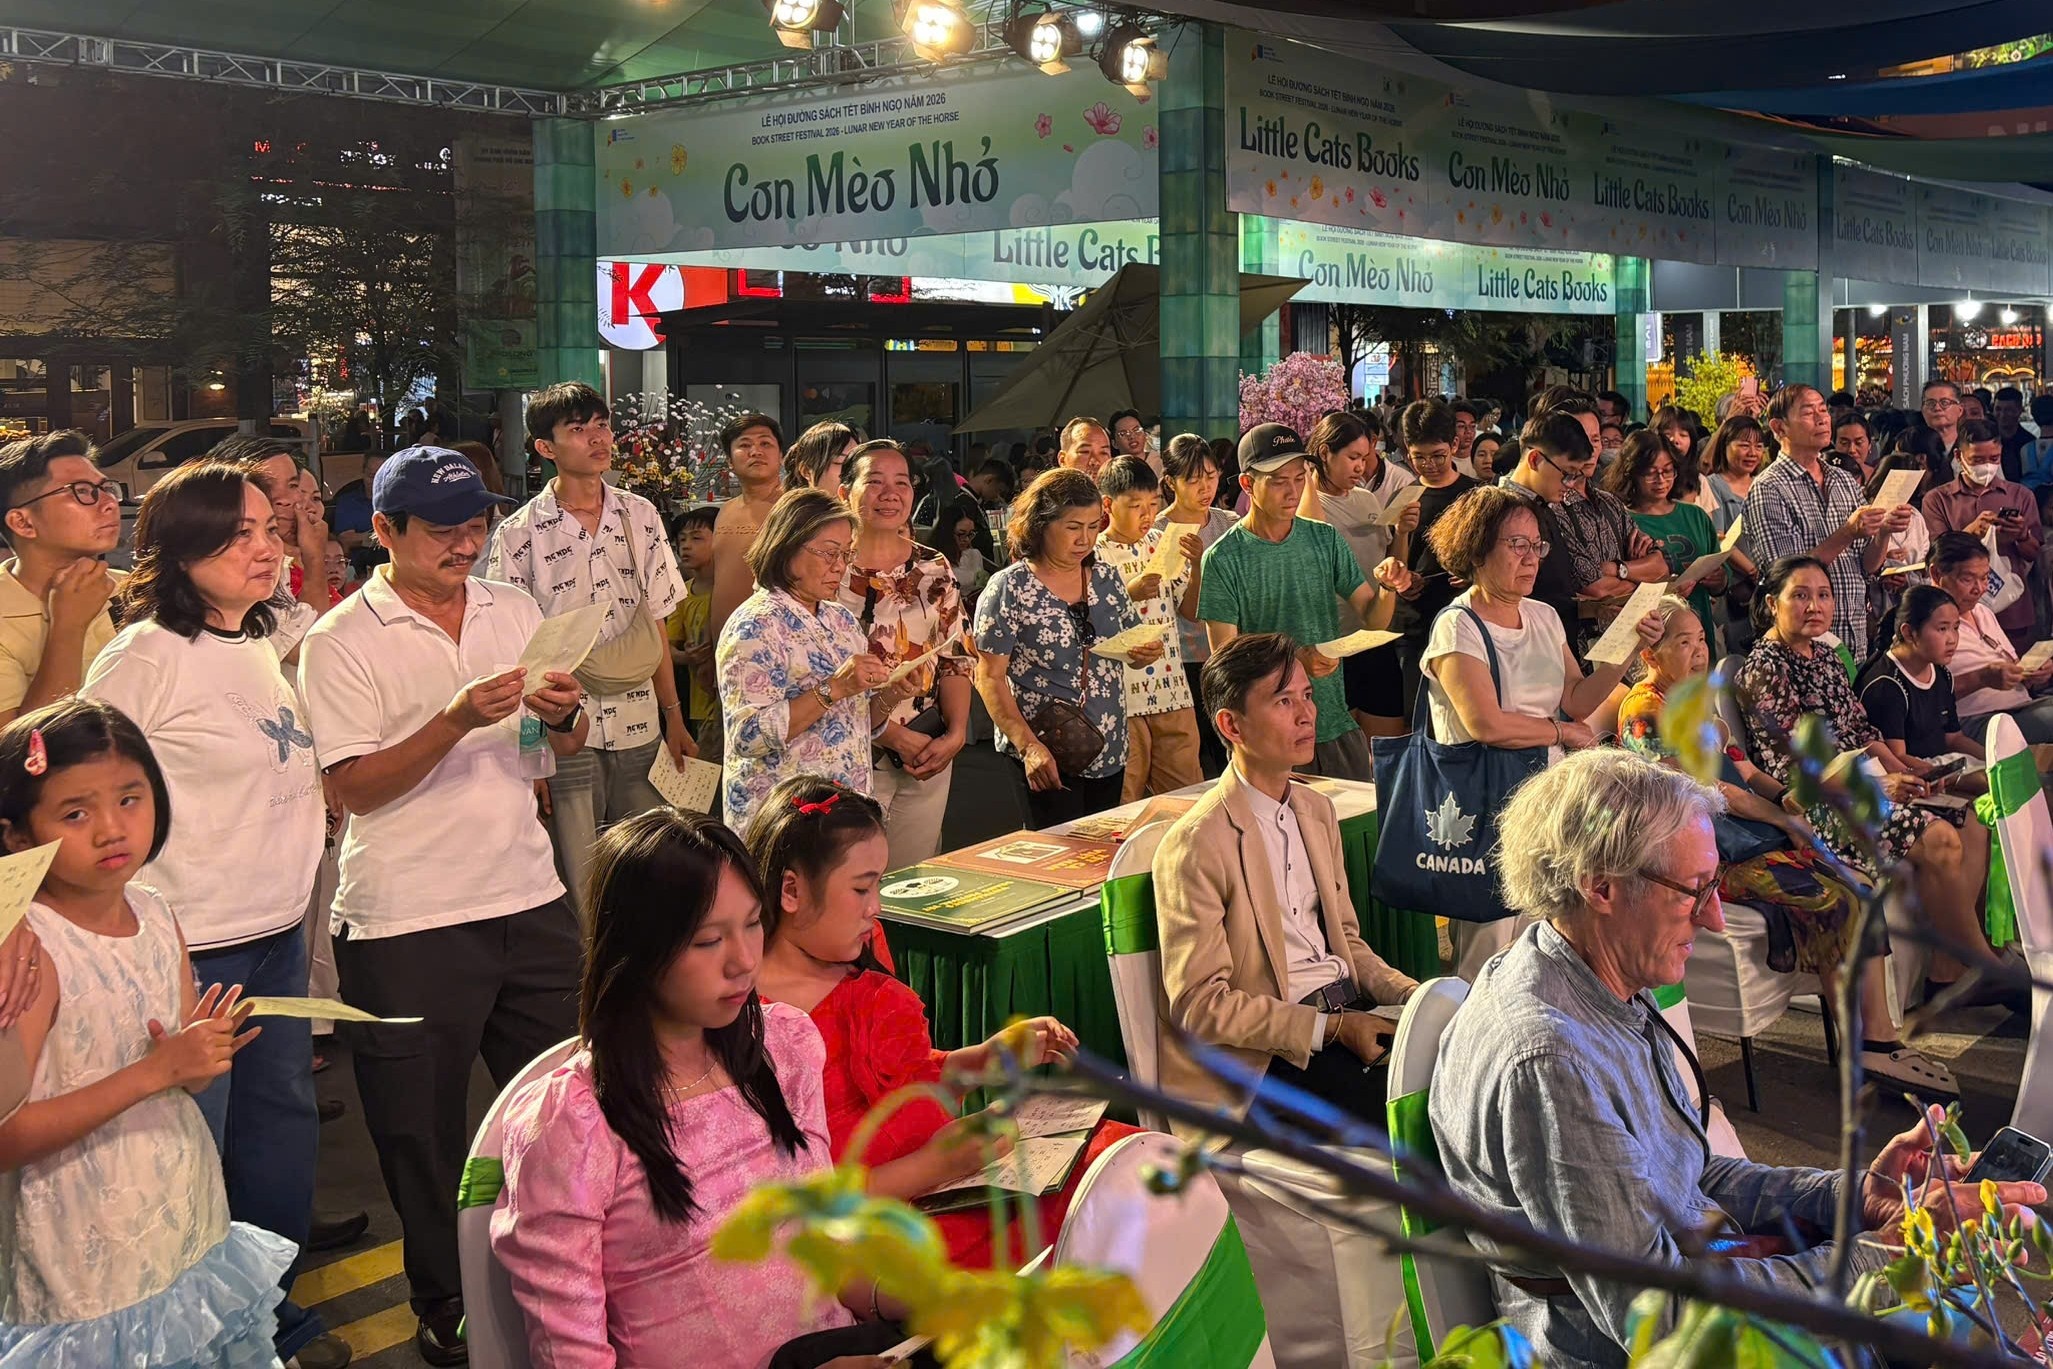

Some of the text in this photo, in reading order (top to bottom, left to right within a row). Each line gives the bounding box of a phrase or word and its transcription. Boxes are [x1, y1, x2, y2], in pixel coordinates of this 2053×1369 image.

[751, 134, 770, 146] BOOK
[771, 132, 794, 144] STREET
[795, 129, 824, 141] FESTIVAL
[825, 126, 840, 137] 2026
[844, 123, 867, 136] LUNAR
[868, 121, 885, 132] NEW
[885, 118, 905, 131] YEAR
[906, 116, 917, 127] OF
[917, 114, 932, 126] THE
[933, 111, 960, 124] HORSE
[773, 113, 786, 128] HỘI
[787, 108, 817, 125] ĐƯỜNG
[818, 105, 841, 121] SÁCH
[843, 102, 858, 117] TẾT
[860, 99, 881, 116] BÍNH
[882, 98, 902, 114] NGỌ
[904, 93, 925, 110] NĂM
[926, 92, 946, 106] 2026
[1240, 106, 1298, 159] Little
[1303, 121, 1352, 168] Cats
[1356, 131, 1420, 183] Books
[723, 135, 999, 223] Con Mèo Nhỏ
[1449, 151, 1486, 191] Con
[1492, 161, 1530, 198] Mèo
[1536, 164, 1570, 202] Nhỏ
[1593, 171, 1631, 210] Little
[1634, 178, 1665, 214] Cats
[1668, 184, 1709, 220] Books
[1836, 212, 1861, 242] Little
[1862, 217, 1884, 245] Cats
[993, 226, 1069, 269] Little
[1078, 228, 1138, 272] Cats
[1346, 252, 1390, 291] Mèo
[1396, 257, 1434, 294] Nhỏ
[1478, 263, 1608, 302] Little Cats Books
[430, 467, 446, 484] NEW
[1415, 851, 1487, 876] CANADA
